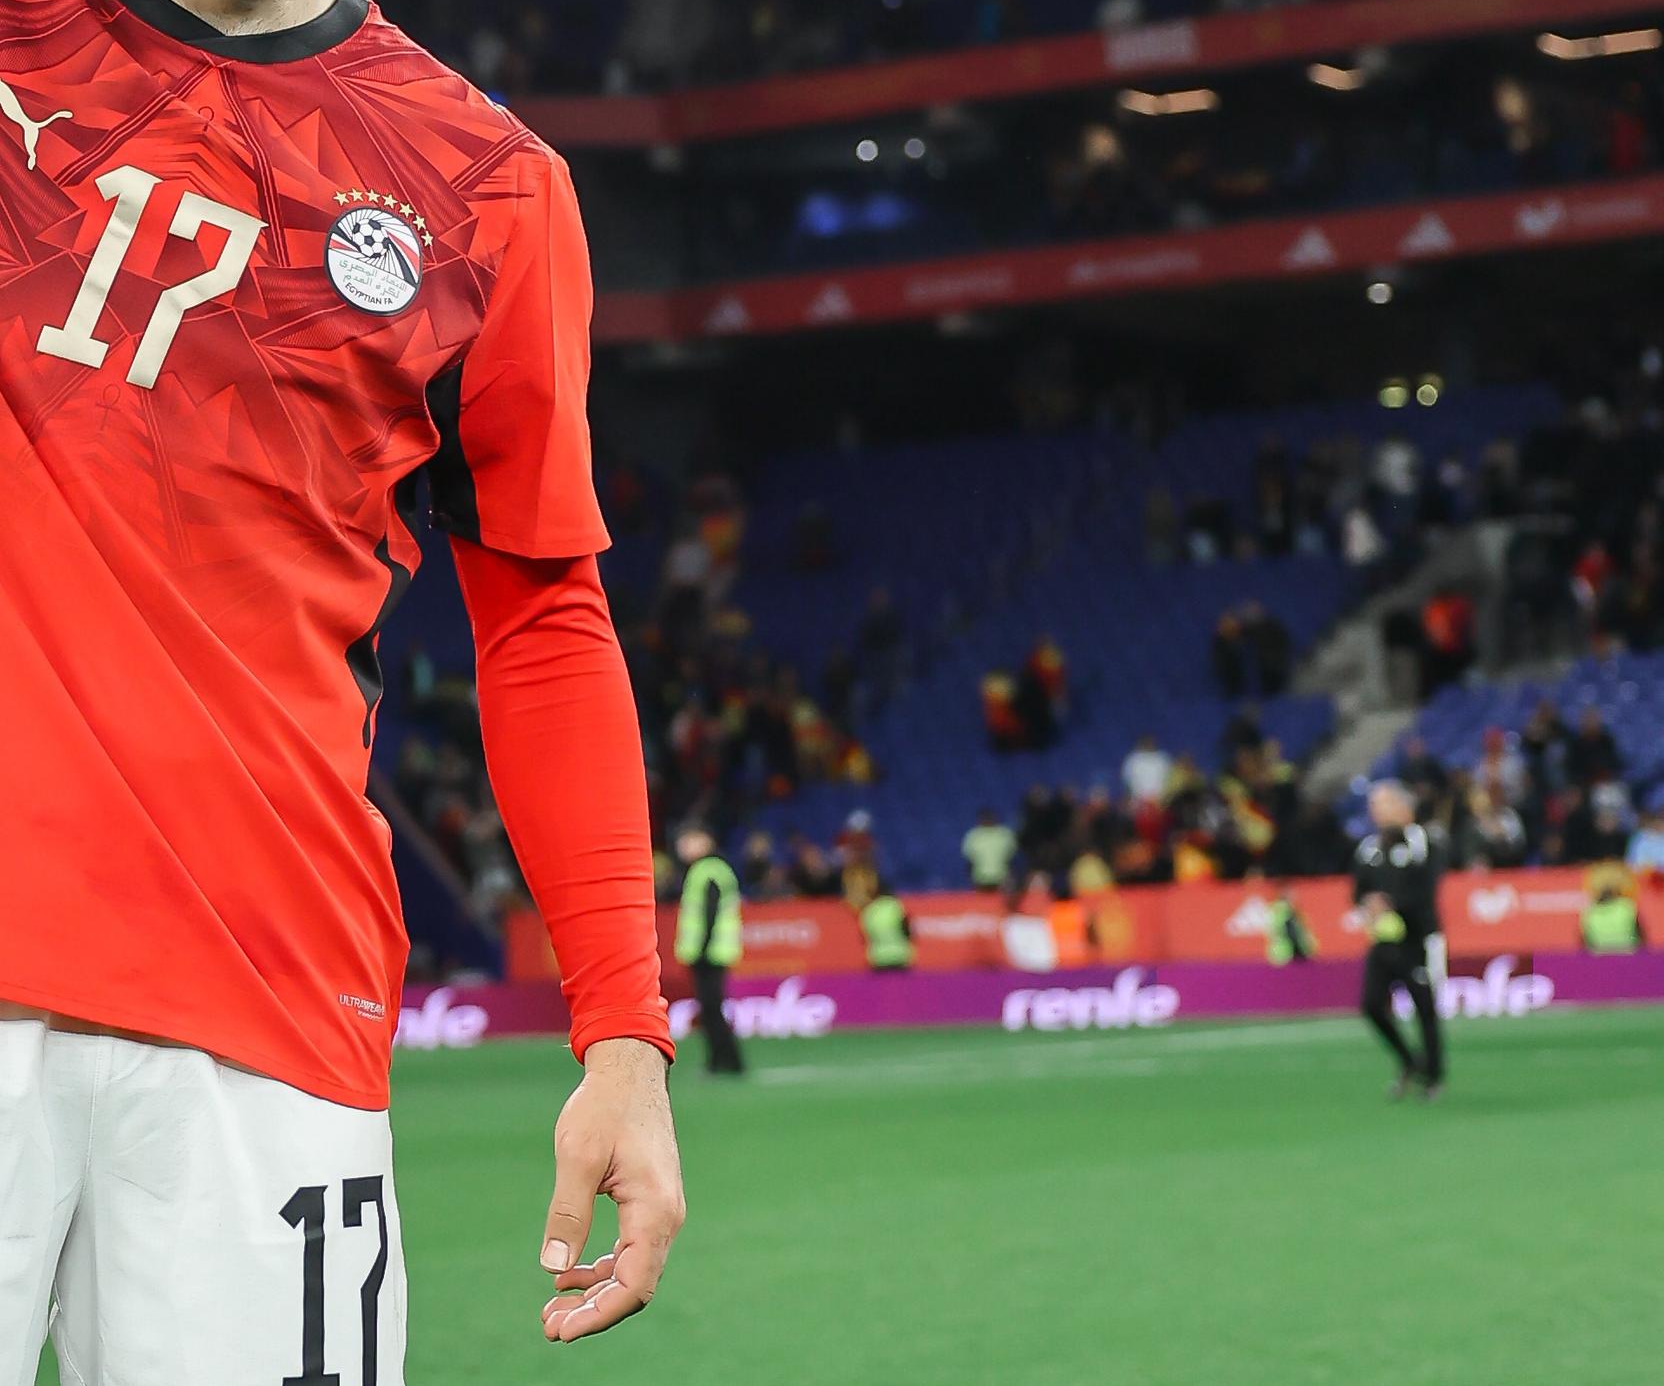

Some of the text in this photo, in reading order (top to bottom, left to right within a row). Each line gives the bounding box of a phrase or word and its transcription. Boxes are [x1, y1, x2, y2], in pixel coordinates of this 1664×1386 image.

[35, 164, 270, 389] 17
[344, 282, 393, 305] EGYPTIAN FA
[1002, 965, 1180, 1032] renfe
